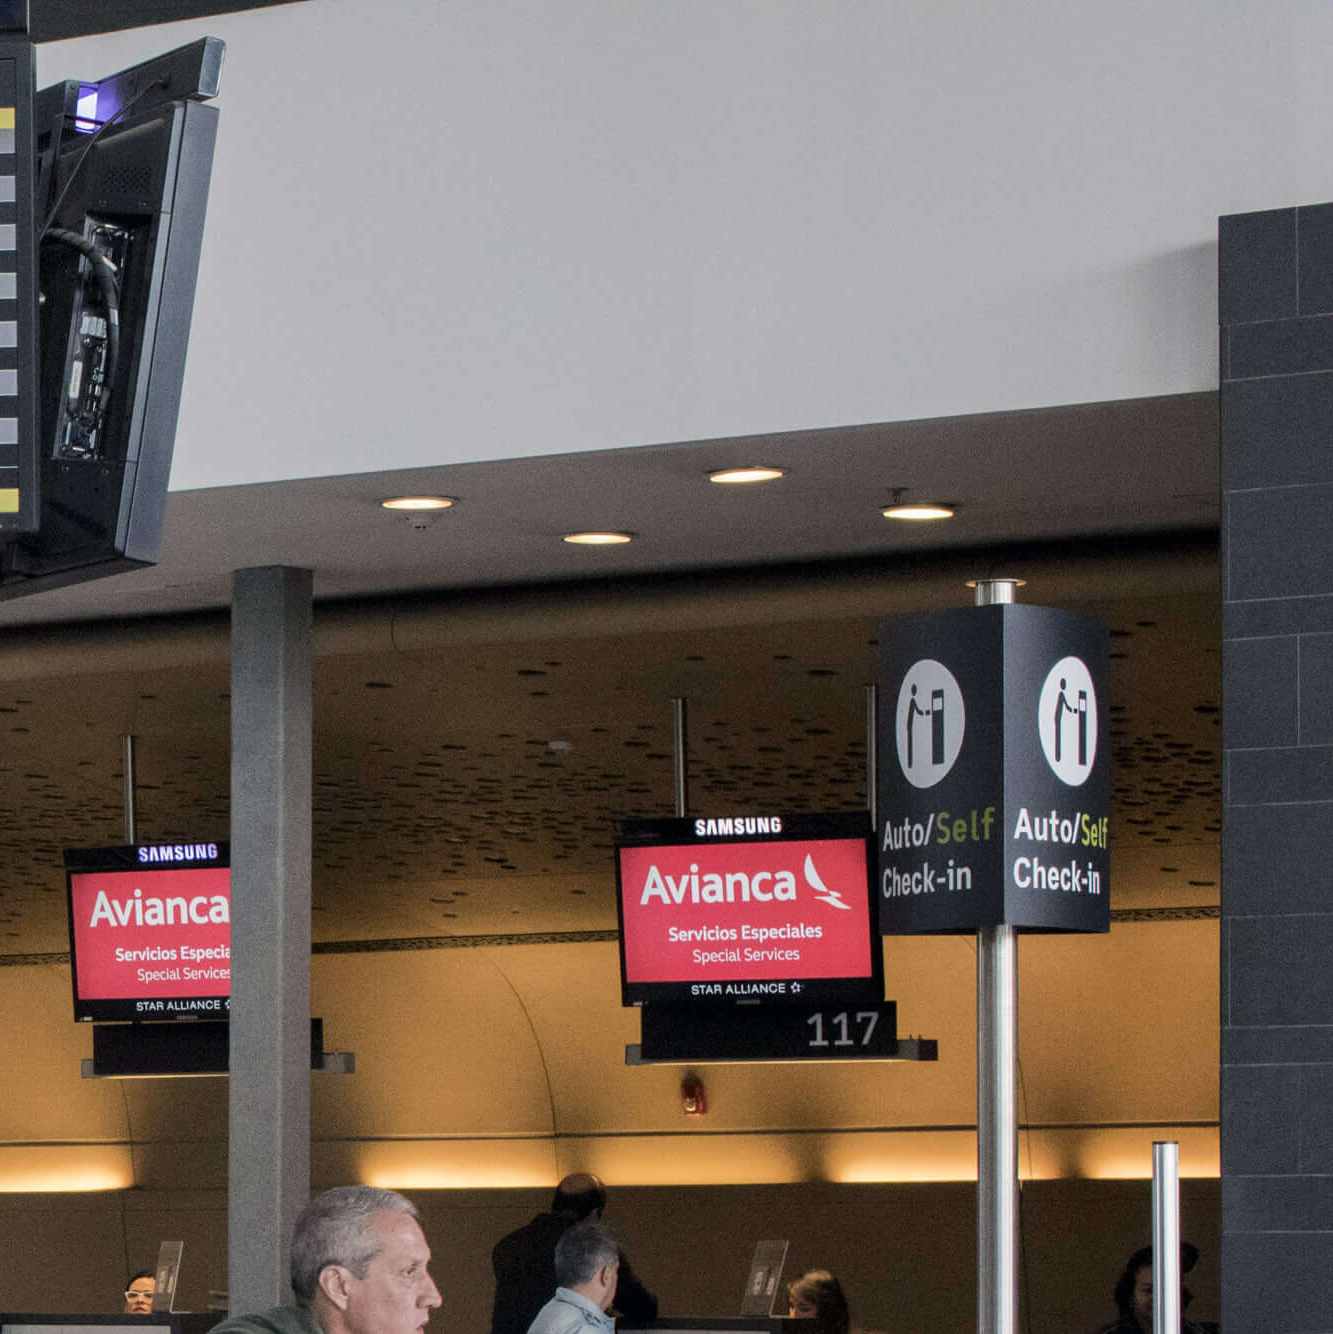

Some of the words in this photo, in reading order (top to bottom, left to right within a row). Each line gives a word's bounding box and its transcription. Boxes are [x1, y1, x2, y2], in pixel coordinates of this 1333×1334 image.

[695, 816, 782, 836] SAMSUNG
[139, 844, 217, 863] SAMSUNG
[640, 863, 796, 905] Avianca
[883, 858, 971, 898] Check-in
[1013, 856, 1100, 895] Check-in
[90, 889, 230, 927] Avianca
[669, 926, 737, 942] Servicios
[741, 923, 822, 942] Especiales
[115, 947, 177, 962] Servicios
[181, 945, 230, 963] Especia
[693, 949, 740, 965] Special
[744, 948, 800, 962] Services
[137, 968, 180, 984] Special
[692, 984, 722, 995] STAR
[726, 983, 785, 994] ALLIANCE
[136, 1002, 164, 1011] STAR
[167, 1000, 221, 1010] ALLIANCE
[807, 1011, 879, 1046] 117
